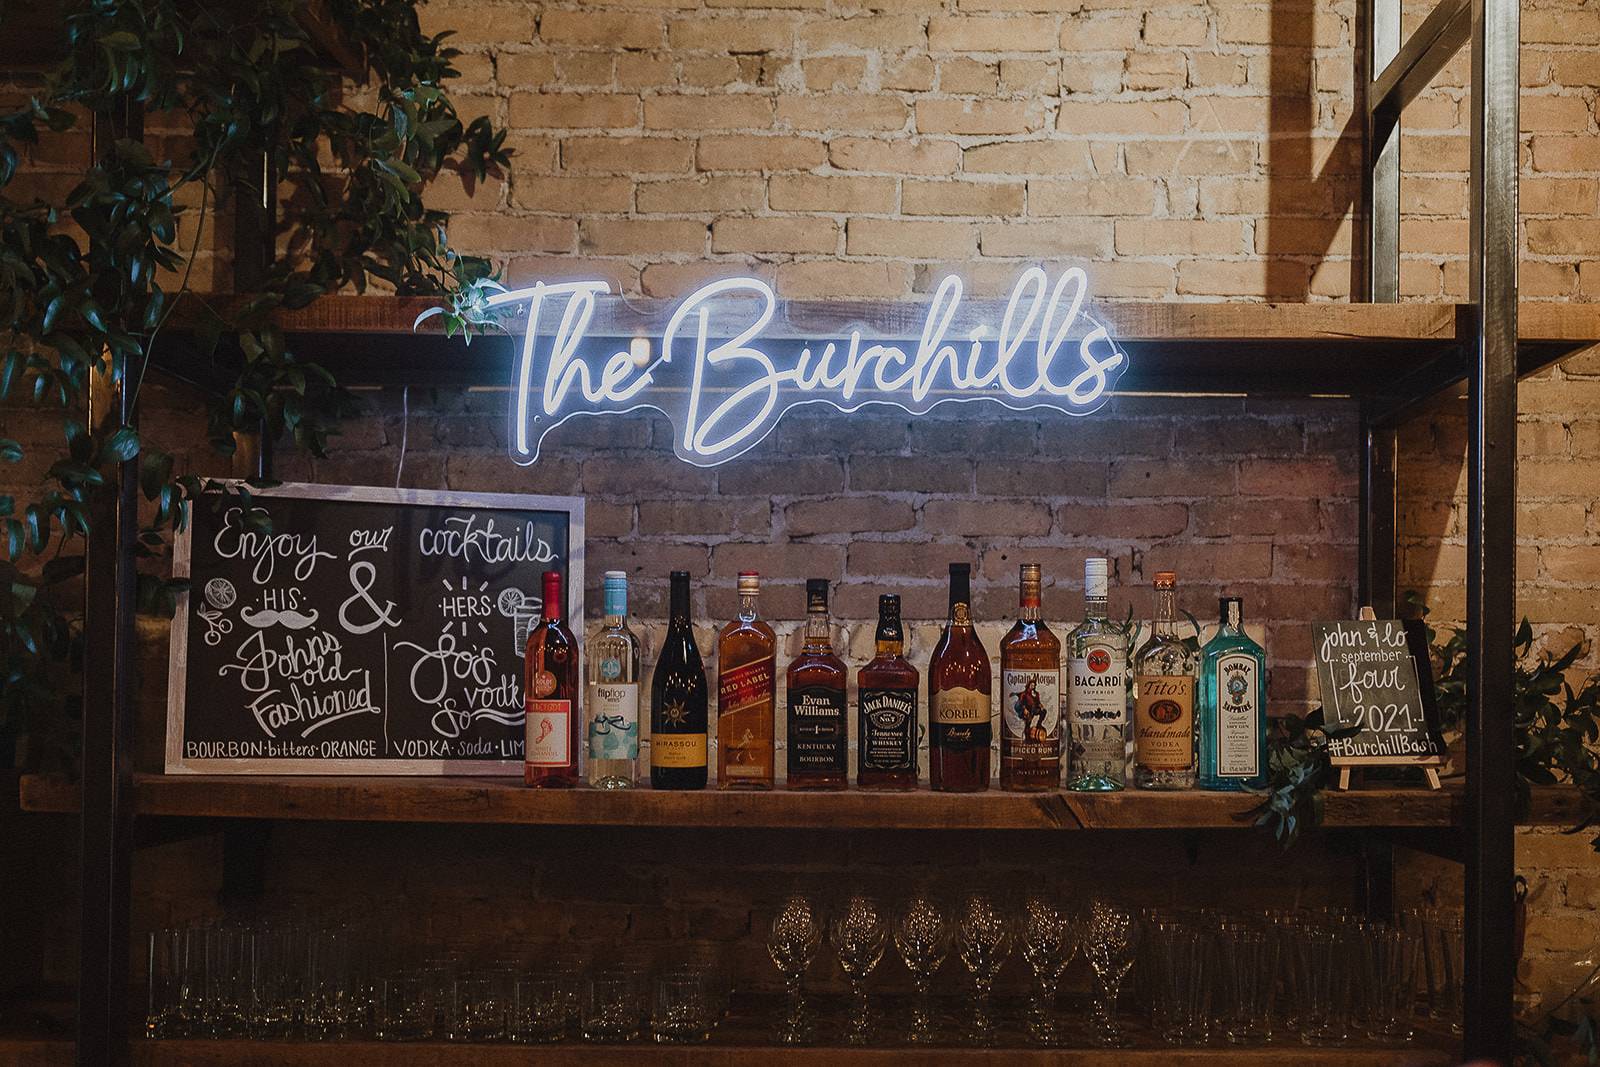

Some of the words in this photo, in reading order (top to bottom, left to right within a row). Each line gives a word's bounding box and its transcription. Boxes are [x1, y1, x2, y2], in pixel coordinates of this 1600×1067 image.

[486, 280, 656, 456] The
[662, 266, 1124, 456] Burchills
[214, 507, 337, 584] Enjoy
[349, 526, 394, 549] our
[420, 514, 559, 563] cocktails
[338, 561, 402, 634] &
[1321, 622, 1366, 663] john
[1341, 650, 1402, 665] september
[1007, 672, 1030, 686] Captain
[1035, 672, 1056, 687] Morgan
[1223, 663, 1251, 676] BOMBAY
[464, 674, 525, 708] vodk
[720, 683, 738, 694] RED
[740, 672, 769, 687] LABEL
[1144, 680, 1187, 696] Tito's
[1340, 662, 1405, 704] four
[244, 669, 374, 738] Fashioned
[802, 694, 831, 706] Evan
[863, 699, 883, 714] JACK
[794, 705, 840, 716] Williams
[939, 709, 979, 719] KORBEL
[1353, 703, 1418, 732] 2021
[393, 740, 451, 757] VODKA
[501, 739, 525, 757] LIM
